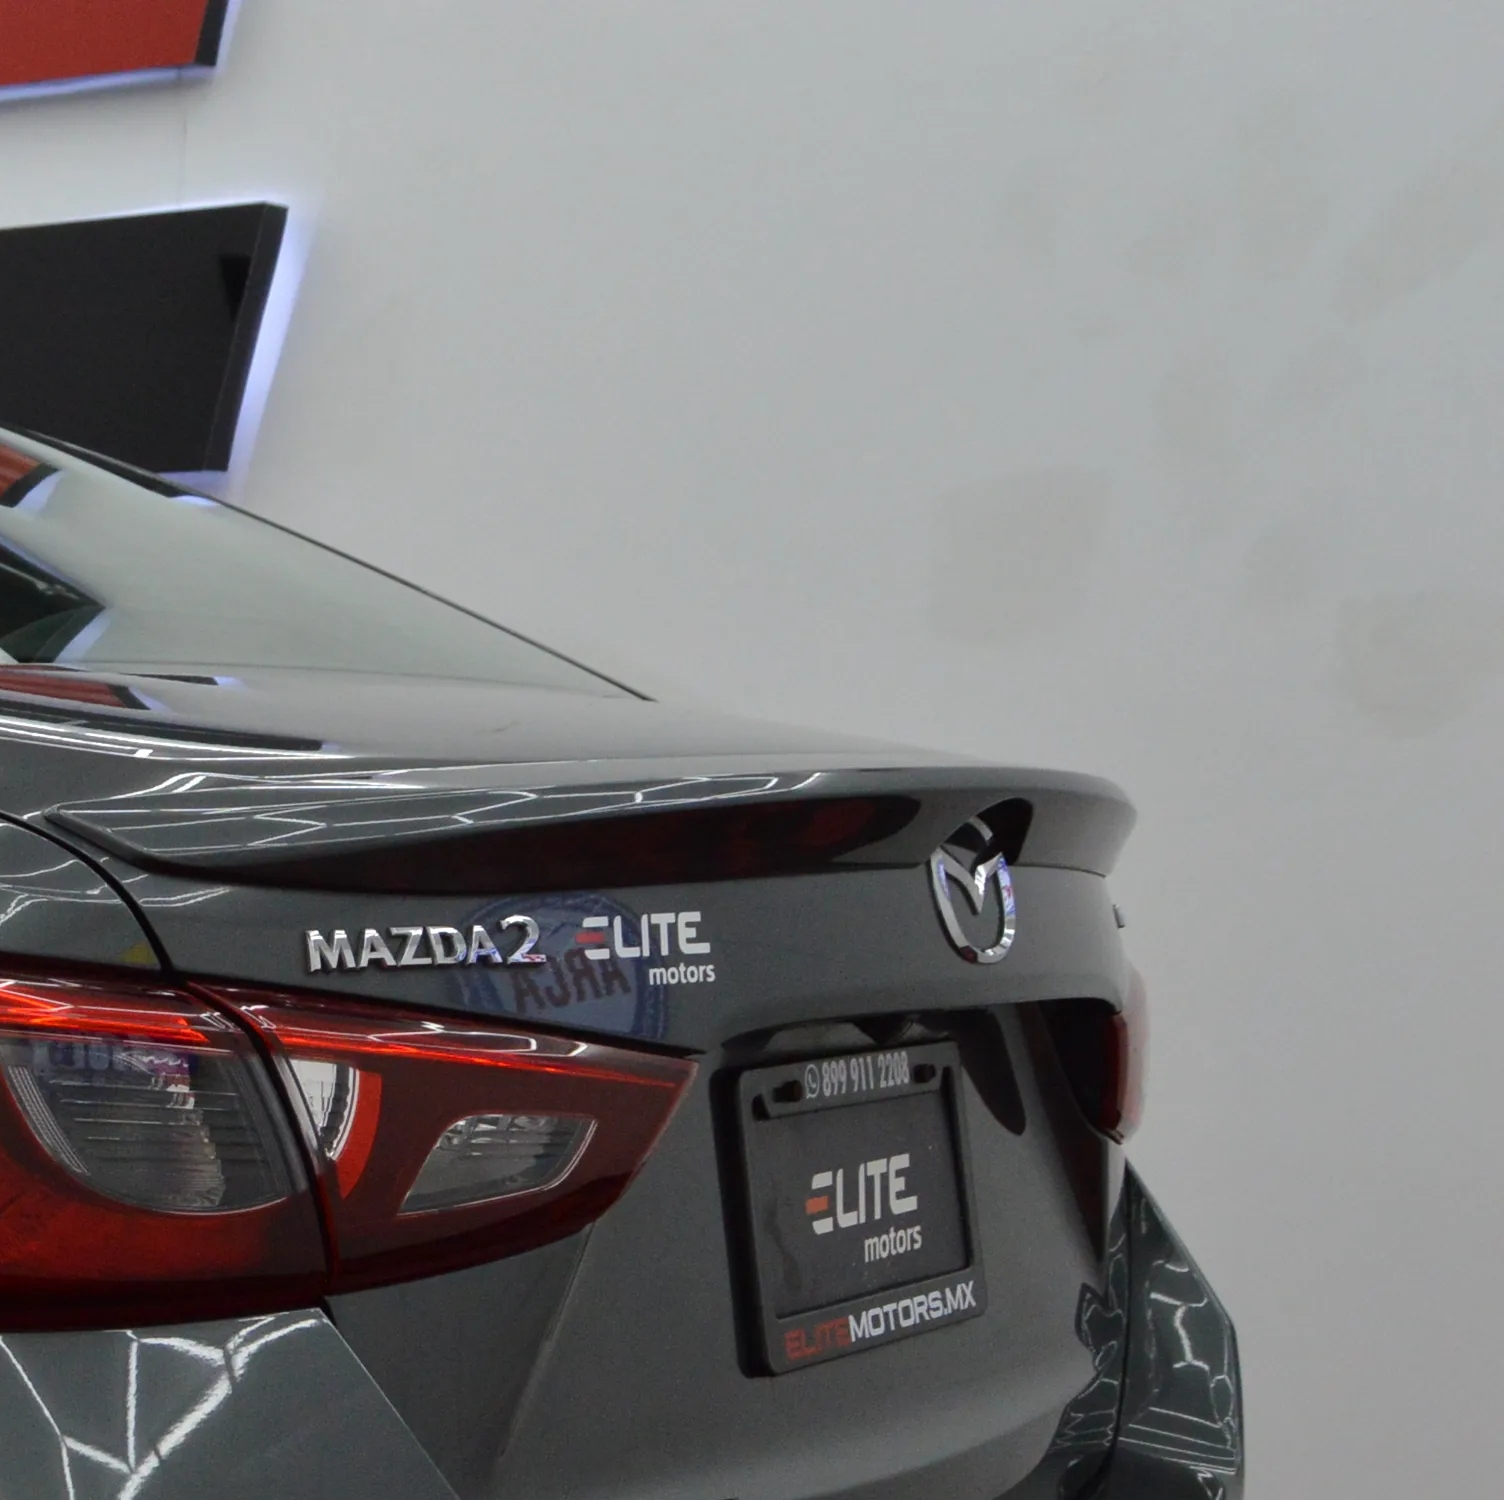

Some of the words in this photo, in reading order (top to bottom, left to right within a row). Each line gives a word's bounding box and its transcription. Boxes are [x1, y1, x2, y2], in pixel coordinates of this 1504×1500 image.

[575, 910, 711, 961] ELITE
[648, 961, 717, 987] motors
[821, 1058, 848, 1098] 899
[850, 1055, 874, 1093] 911
[878, 1050, 910, 1089] 2208
[804, 1152, 918, 1236] ELITE
[864, 1226, 923, 1264] motors
[784, 1280, 977, 1361] ELITEMOTORS.MX
